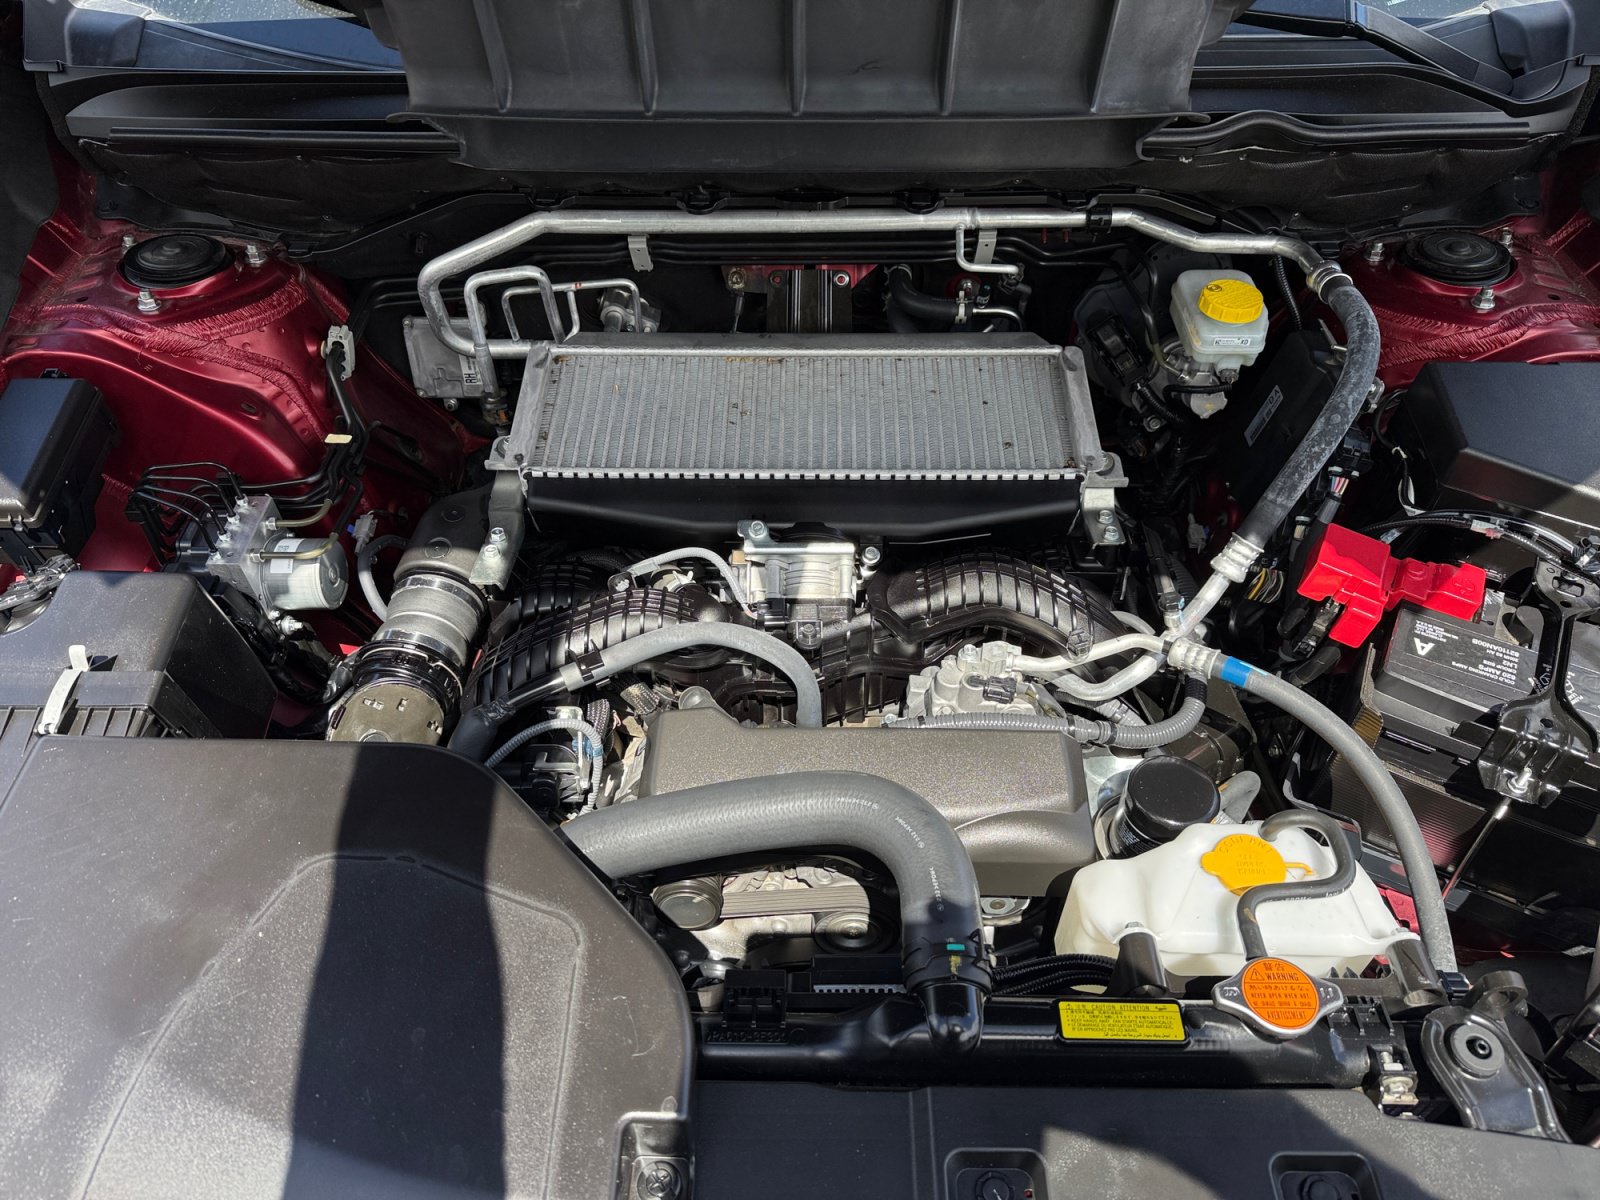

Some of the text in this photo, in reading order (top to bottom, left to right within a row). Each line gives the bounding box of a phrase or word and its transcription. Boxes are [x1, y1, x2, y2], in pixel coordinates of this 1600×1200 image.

[464, 373, 477, 384] RH
[1413, 637, 1436, 656] A
[1478, 664, 1501, 675] AMPS
[1482, 659, 1517, 673] GROUP SIZE
[1502, 659, 1518, 669] LN2
[1452, 661, 1515, 685] COLD CRANKING AMPS
[1265, 972, 1299, 981] WARNING
